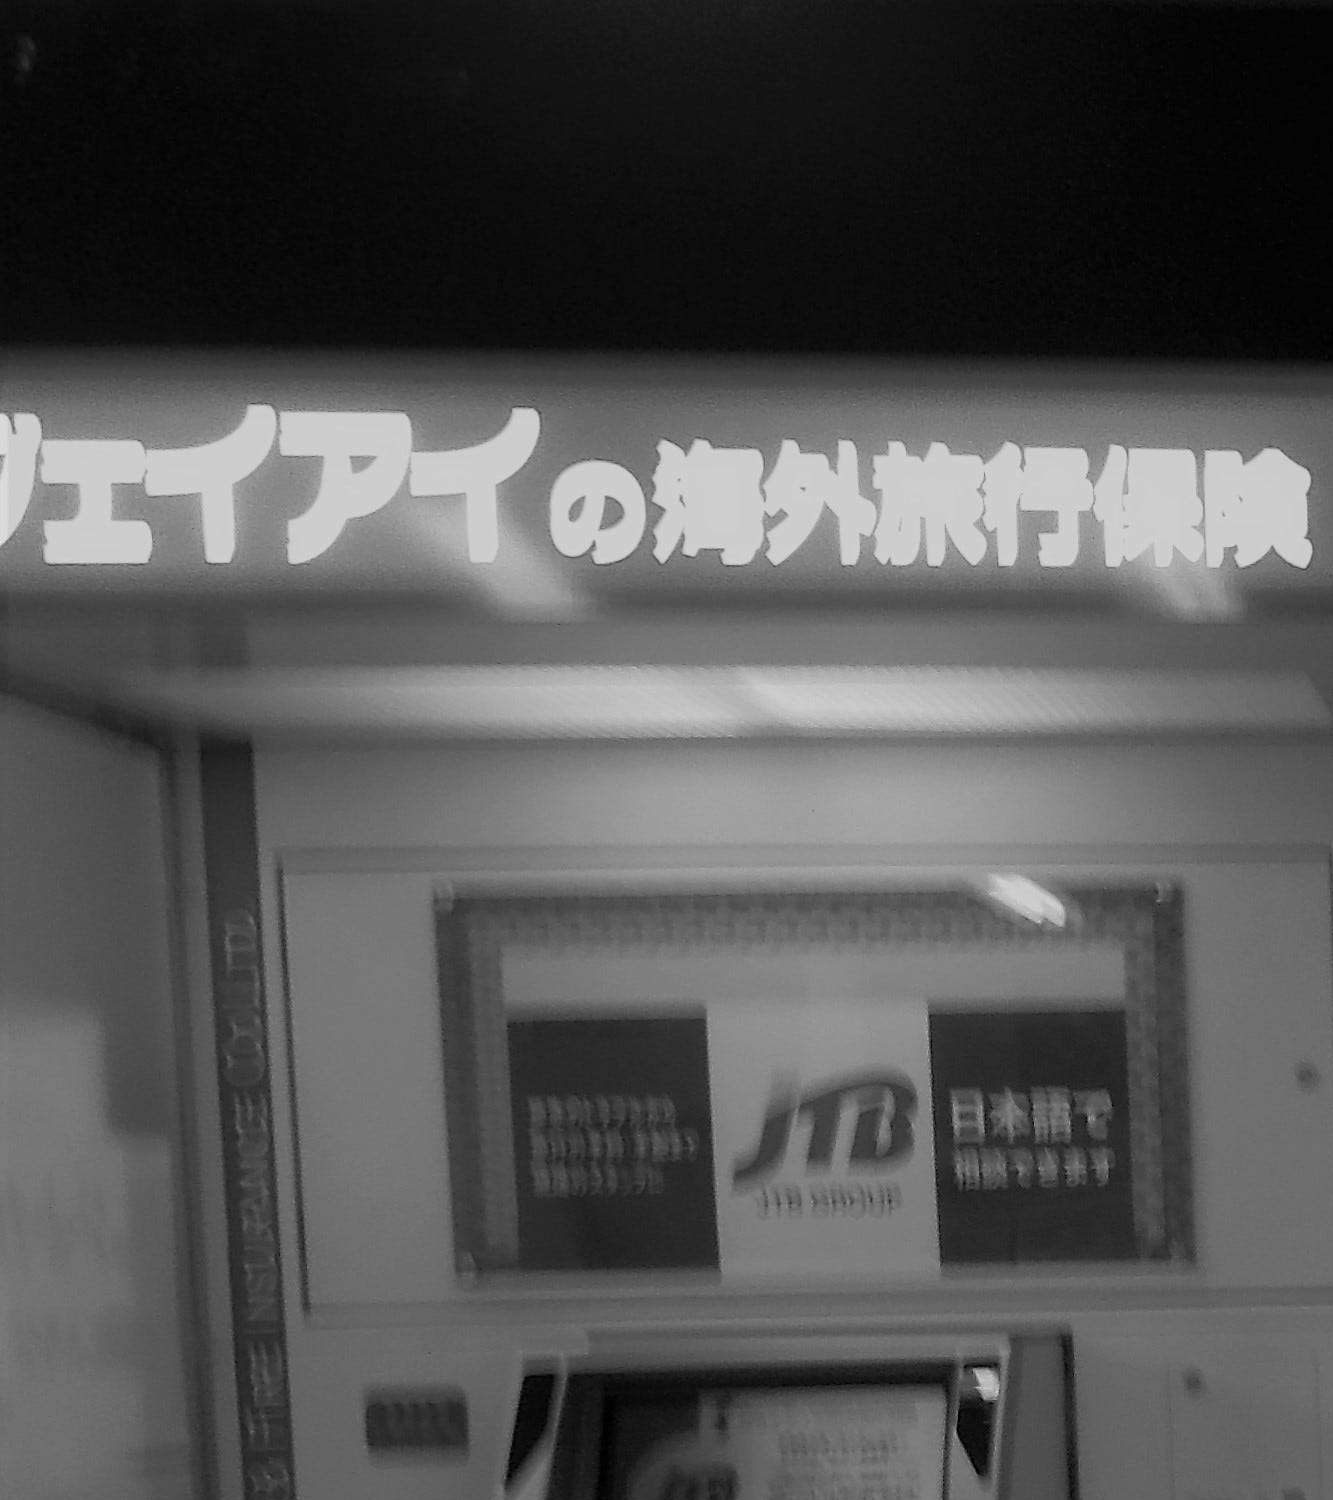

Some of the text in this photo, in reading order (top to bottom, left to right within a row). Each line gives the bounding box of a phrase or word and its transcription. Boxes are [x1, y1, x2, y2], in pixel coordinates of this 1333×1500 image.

[732, 1065, 918, 1192] JTB
[950, 1087, 1113, 1143] 日本語で
